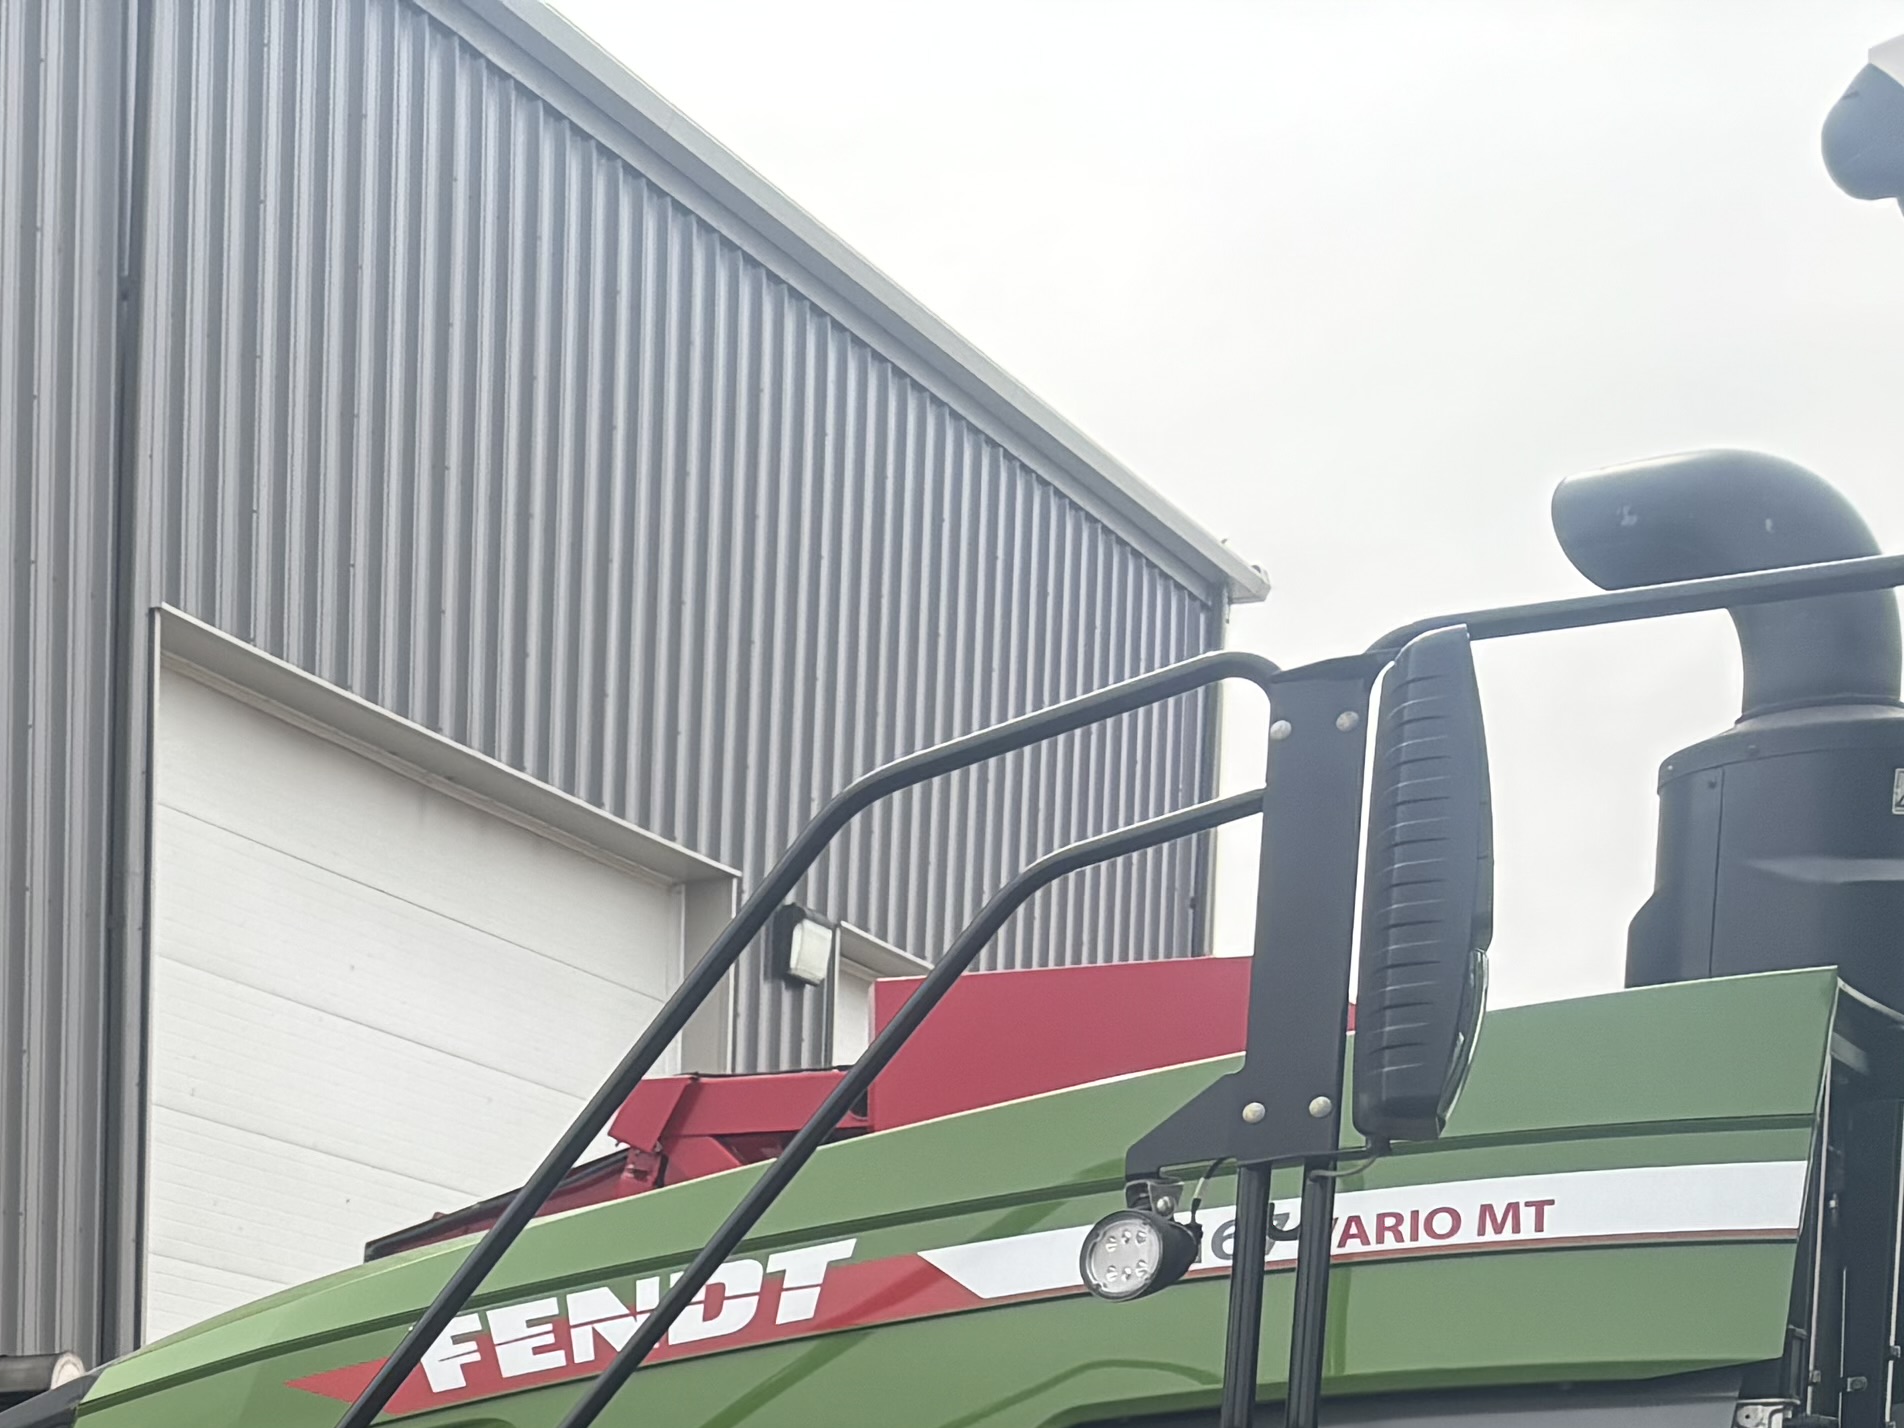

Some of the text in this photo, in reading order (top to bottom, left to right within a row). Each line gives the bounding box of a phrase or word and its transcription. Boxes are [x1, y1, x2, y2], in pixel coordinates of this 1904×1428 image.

[1330, 1206, 1462, 1248] ARIO
[1476, 1199, 1556, 1237] MT
[410, 1239, 856, 1392] FENDT
